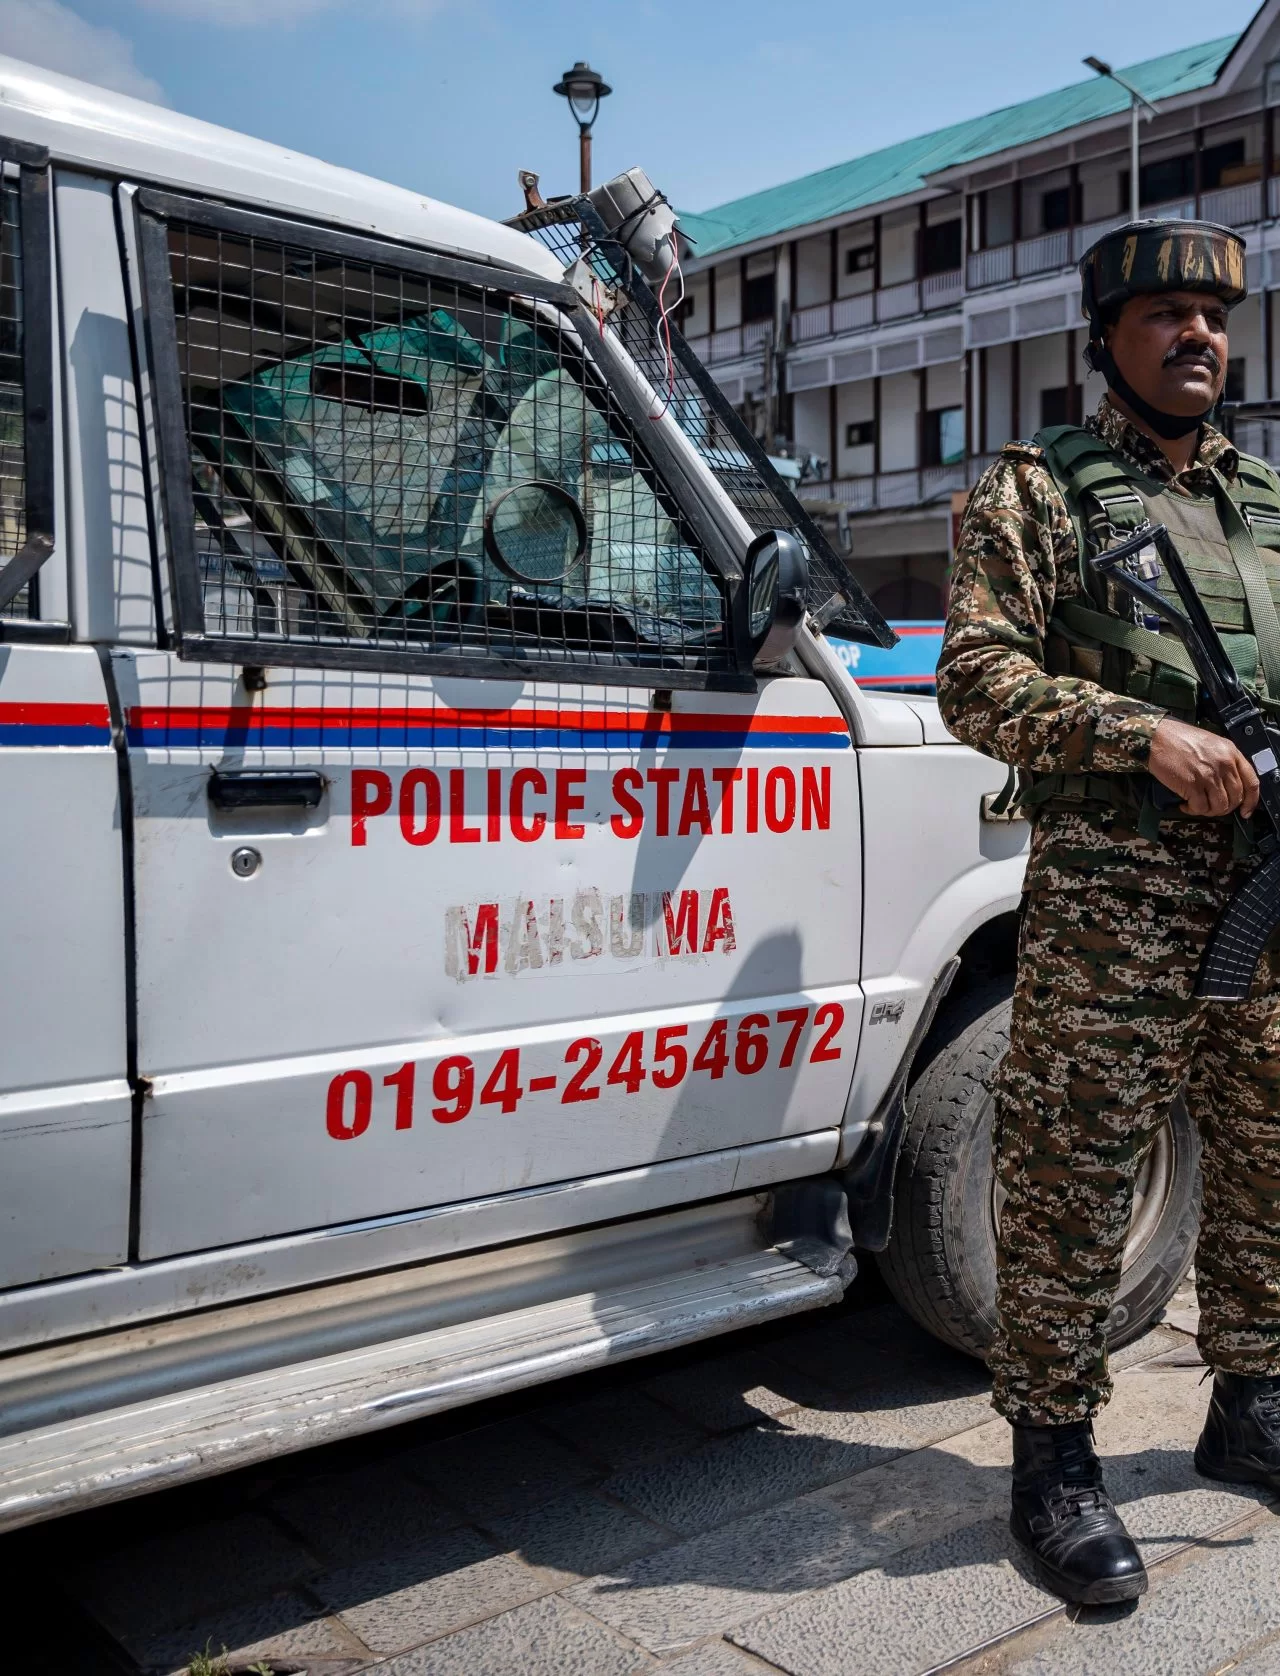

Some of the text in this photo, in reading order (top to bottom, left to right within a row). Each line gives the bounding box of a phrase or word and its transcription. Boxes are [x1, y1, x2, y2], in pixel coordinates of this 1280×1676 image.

[350, 765, 832, 847] POLICE STATION
[444, 886, 738, 981] MAISUMA
[325, 1002, 845, 1141] 0194-2454672
